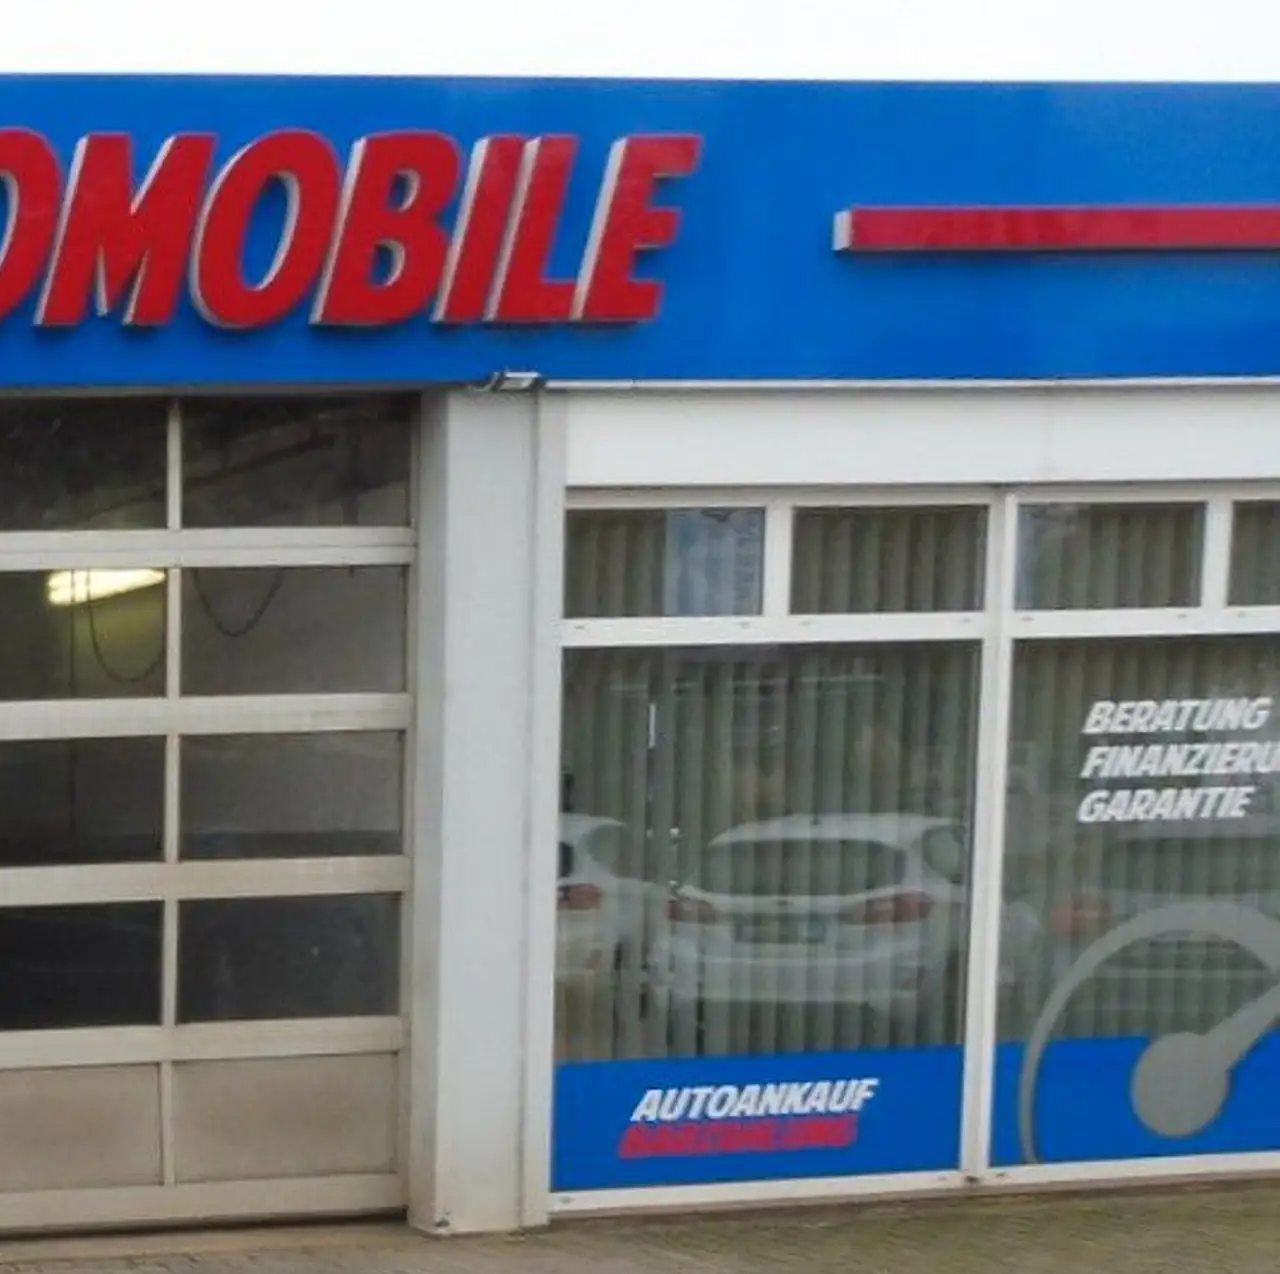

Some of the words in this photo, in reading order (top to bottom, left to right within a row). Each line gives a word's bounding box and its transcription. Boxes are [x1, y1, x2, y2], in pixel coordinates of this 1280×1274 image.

[1081, 697, 1273, 735] BERATUNG
[1076, 786, 1257, 823] GARANTIE
[629, 1077, 881, 1122] AUTOANKAUF
